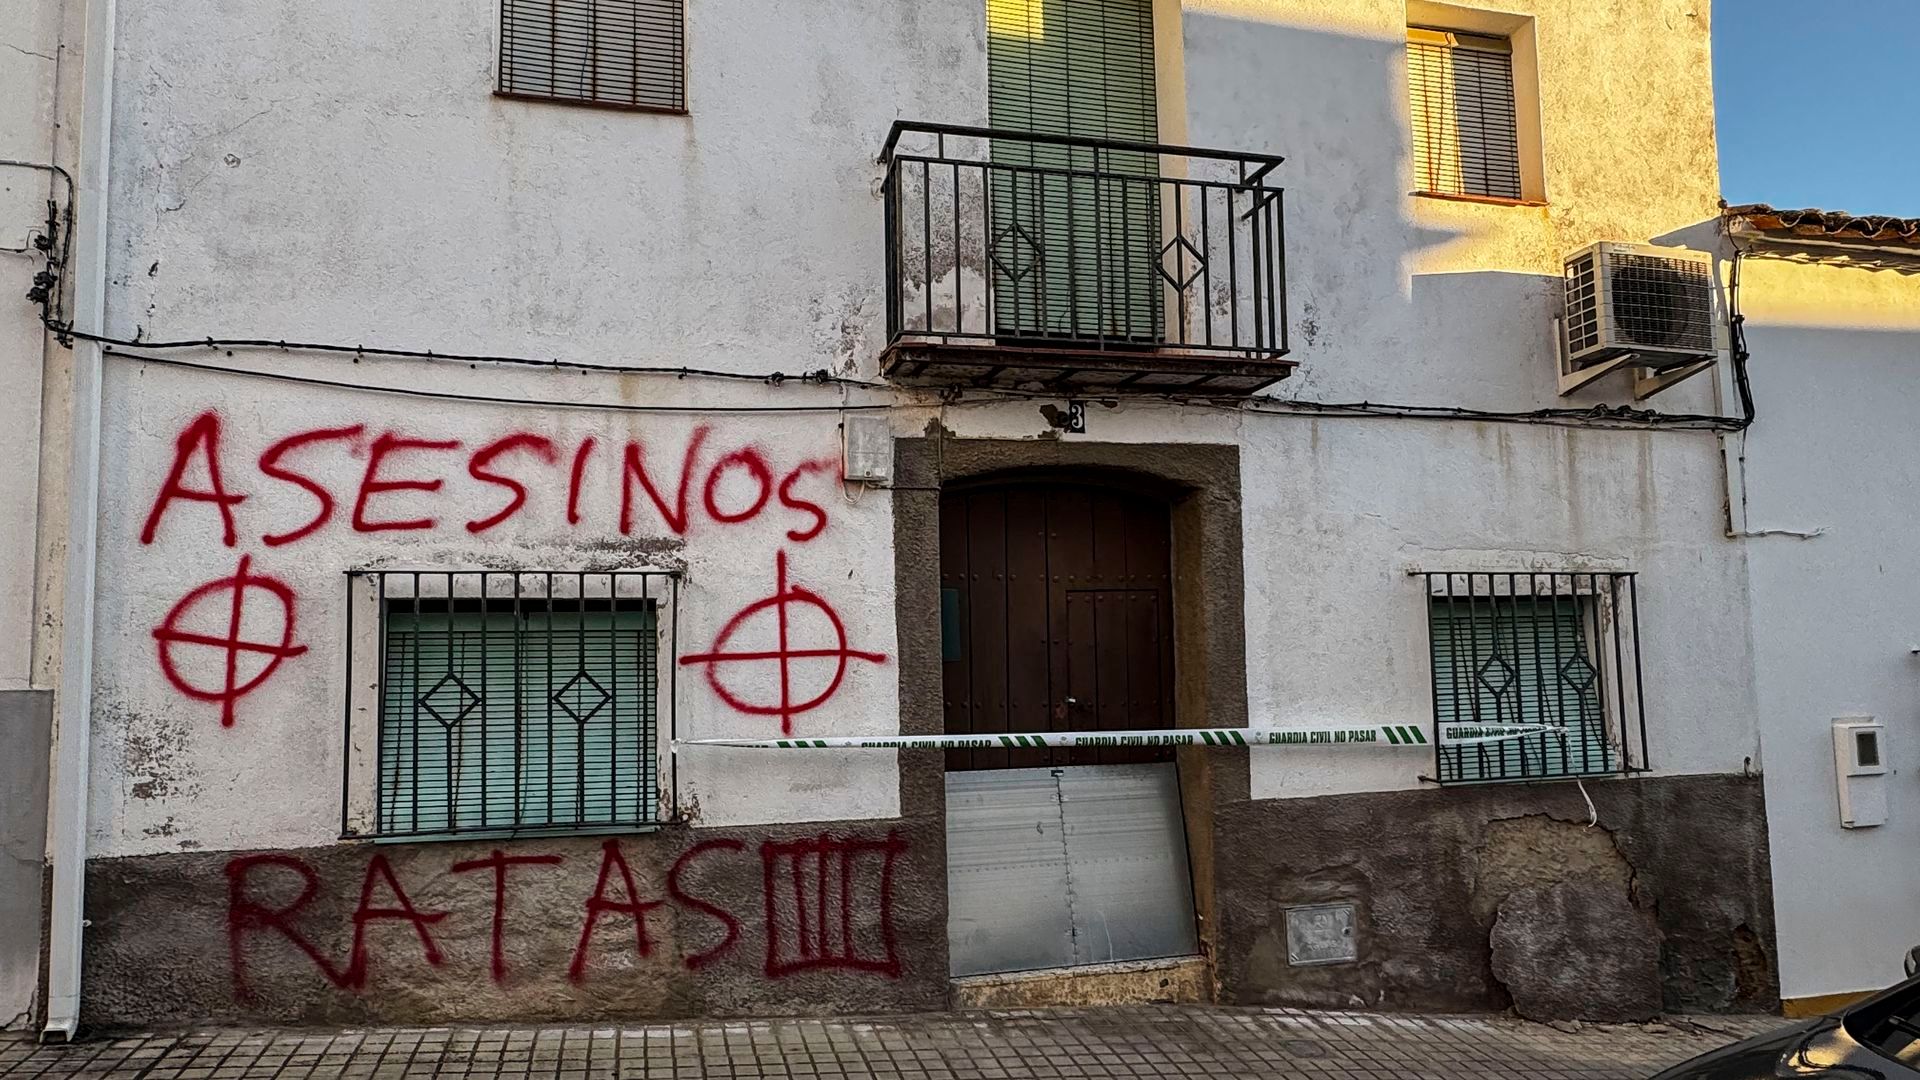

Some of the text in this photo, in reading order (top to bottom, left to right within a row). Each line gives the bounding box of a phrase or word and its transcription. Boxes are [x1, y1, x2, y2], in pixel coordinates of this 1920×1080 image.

[1071, 404, 1084, 429] 3
[140, 409, 846, 549] ASESINOS
[1075, 734, 1194, 747] GUARDIA CIVIL NO PASAR
[1269, 729, 1377, 745] GUARDIA CIVIL NO PASAR
[1446, 726, 1483, 740] GUARDIA
[226, 837, 745, 1001] RATAS
